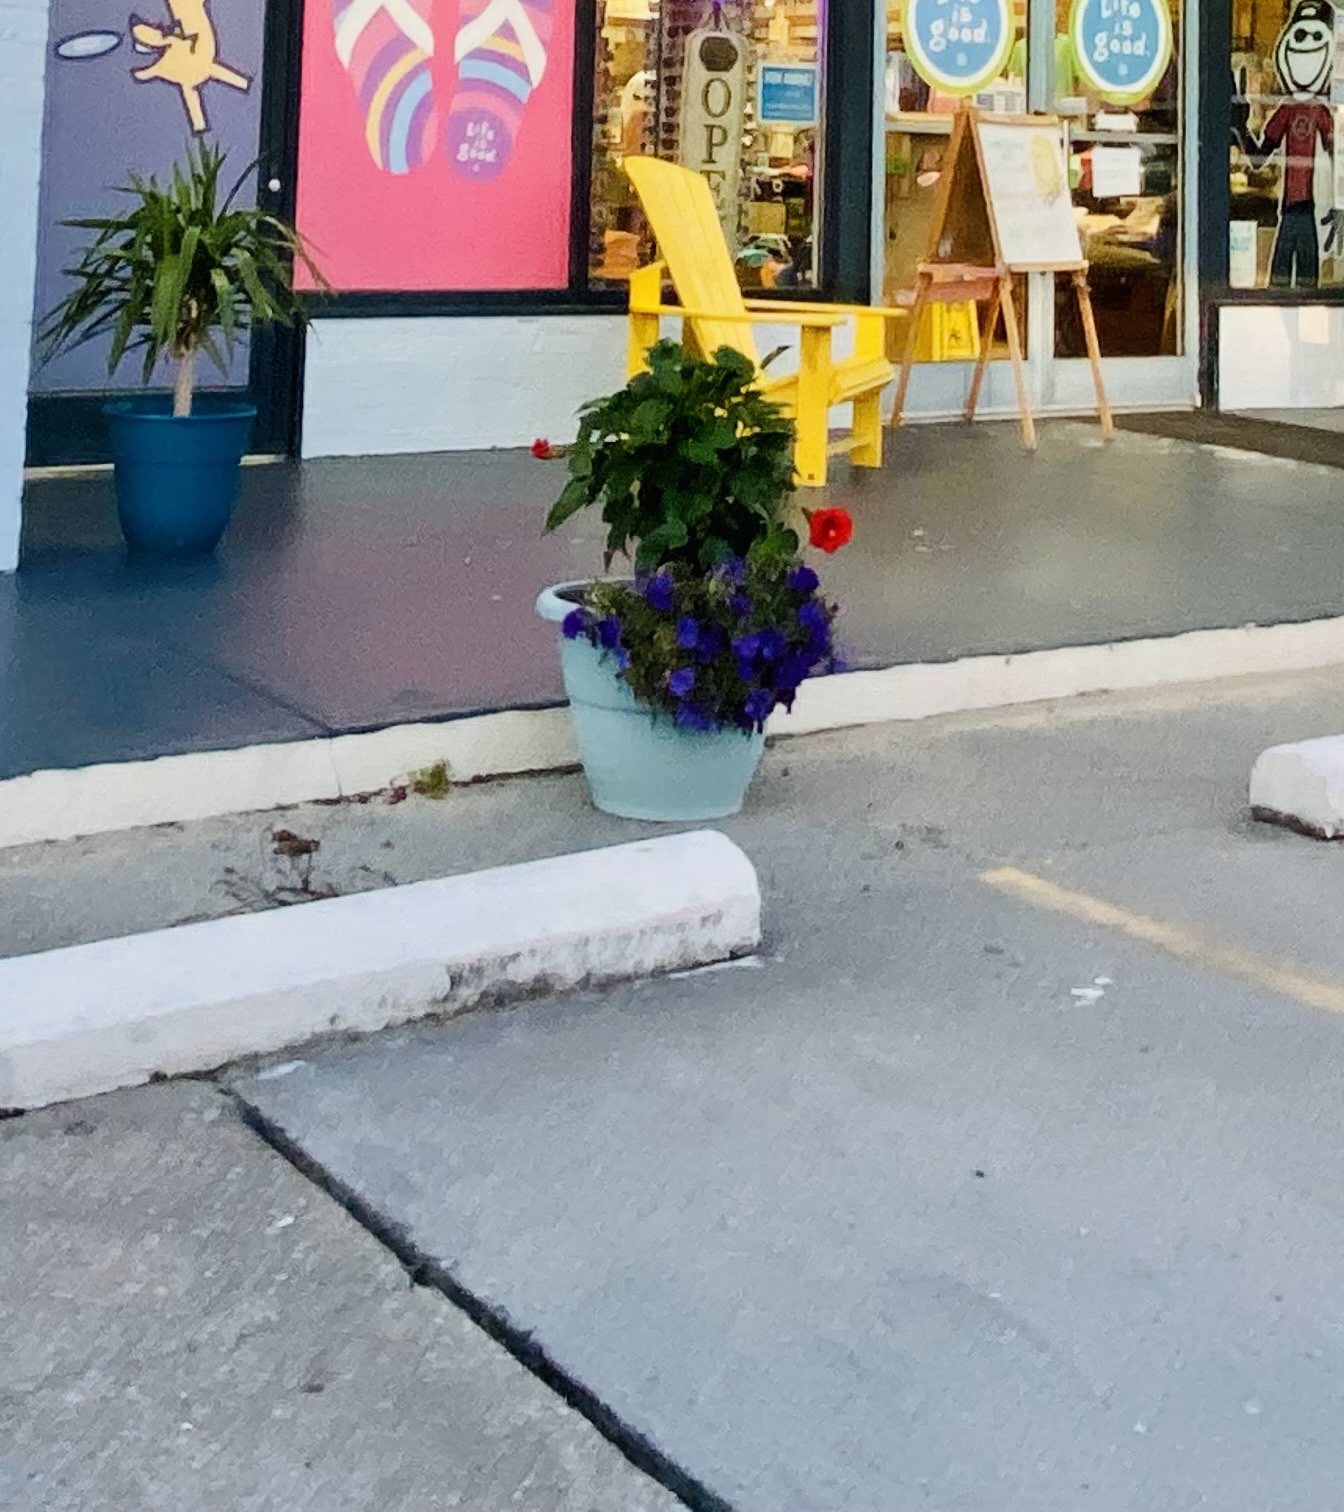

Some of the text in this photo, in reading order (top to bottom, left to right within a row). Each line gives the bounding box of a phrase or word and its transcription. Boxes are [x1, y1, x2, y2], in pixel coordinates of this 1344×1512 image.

[952, 4, 972, 23] is
[1113, 20, 1133, 36] is
[700, 77, 732, 220] OPE
